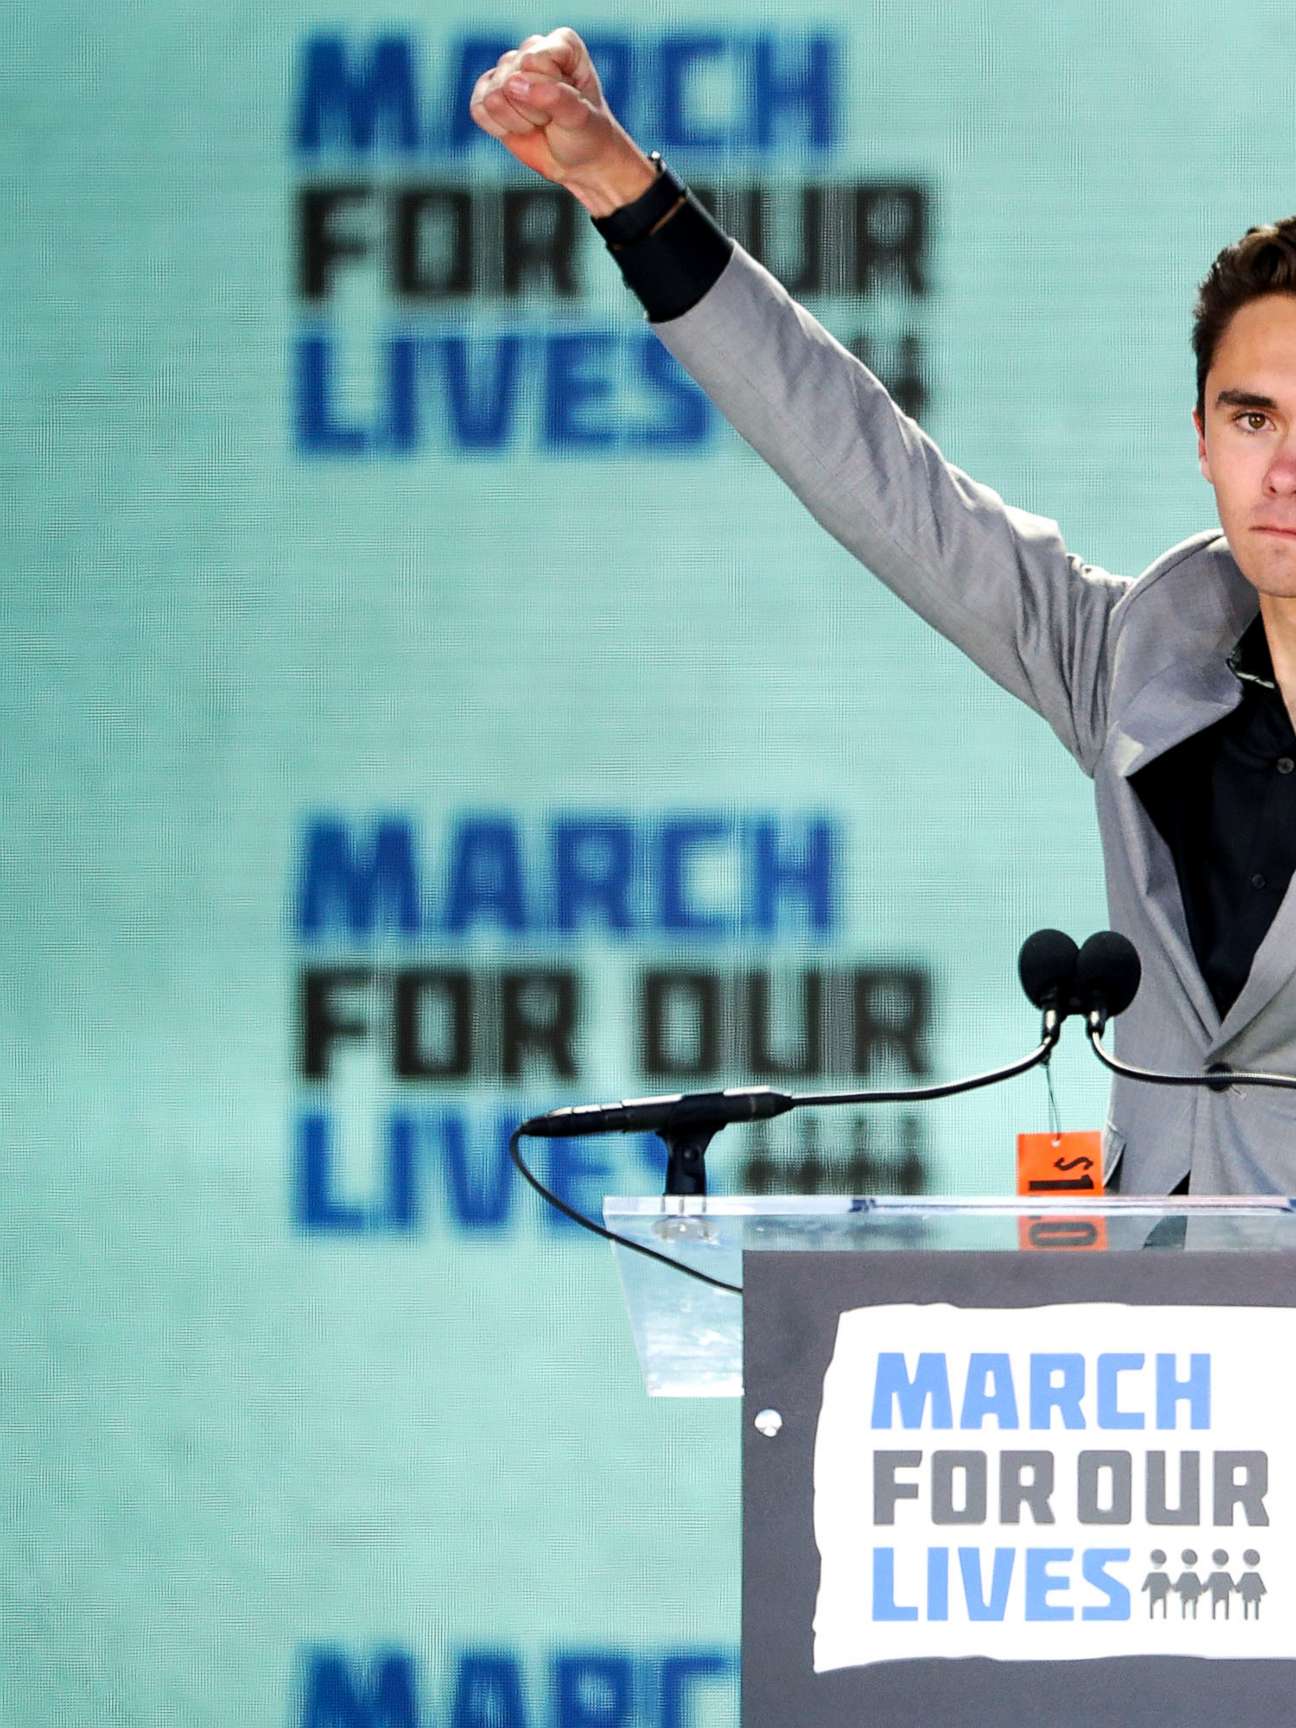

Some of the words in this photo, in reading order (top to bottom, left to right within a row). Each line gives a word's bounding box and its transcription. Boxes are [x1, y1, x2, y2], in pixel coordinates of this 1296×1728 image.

[302, 186, 579, 297] FOR
[297, 334, 710, 452] LIVES
[299, 818, 836, 934] MARCH
[302, 968, 578, 1080] FOR
[640, 968, 930, 1080] OUR
[870, 1352, 1211, 1430] MARCH
[873, 1450, 1055, 1526] FOR
[1077, 1450, 1270, 1526] OUR
[871, 1546, 1131, 1622] LIVES
